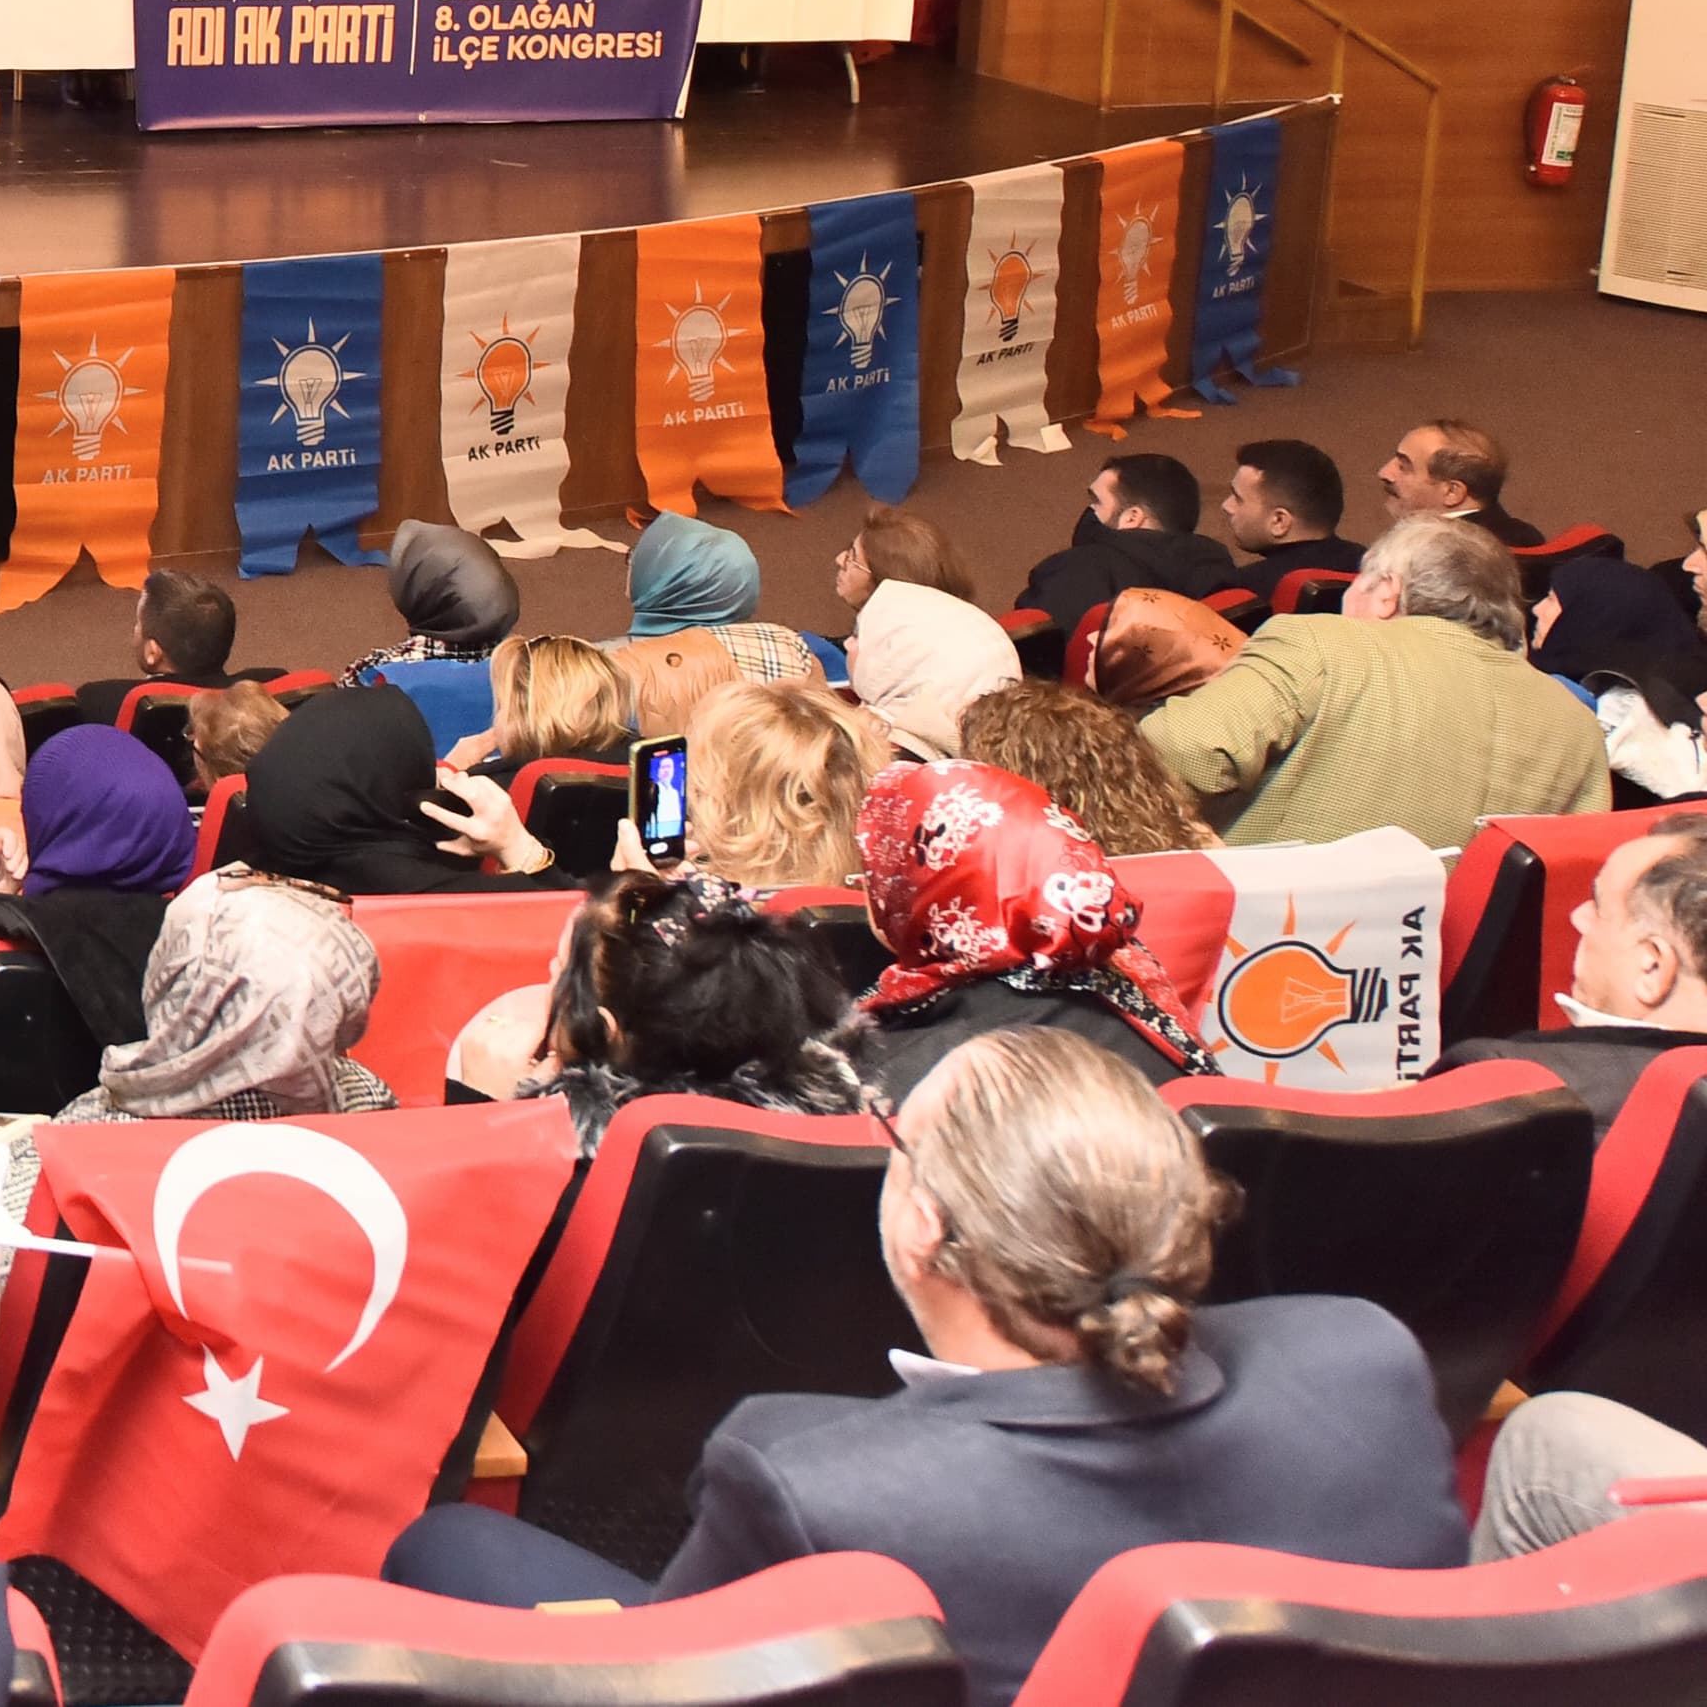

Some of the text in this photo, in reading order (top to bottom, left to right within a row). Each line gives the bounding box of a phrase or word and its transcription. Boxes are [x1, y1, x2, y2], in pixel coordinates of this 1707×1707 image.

[434, 5, 461, 32] 8.
[167, 6, 226, 67] ADI
[234, 5, 283, 66] AK
[1212, 284, 1226, 299] AK
[1111, 314, 1127, 330] AK
[976, 351, 993, 366] AK
[826, 375, 848, 393] AK
[663, 409, 687, 428] AK
[267, 453, 295, 472] AK
[468, 445, 490, 463] AK
[41, 468, 70, 486] AK
